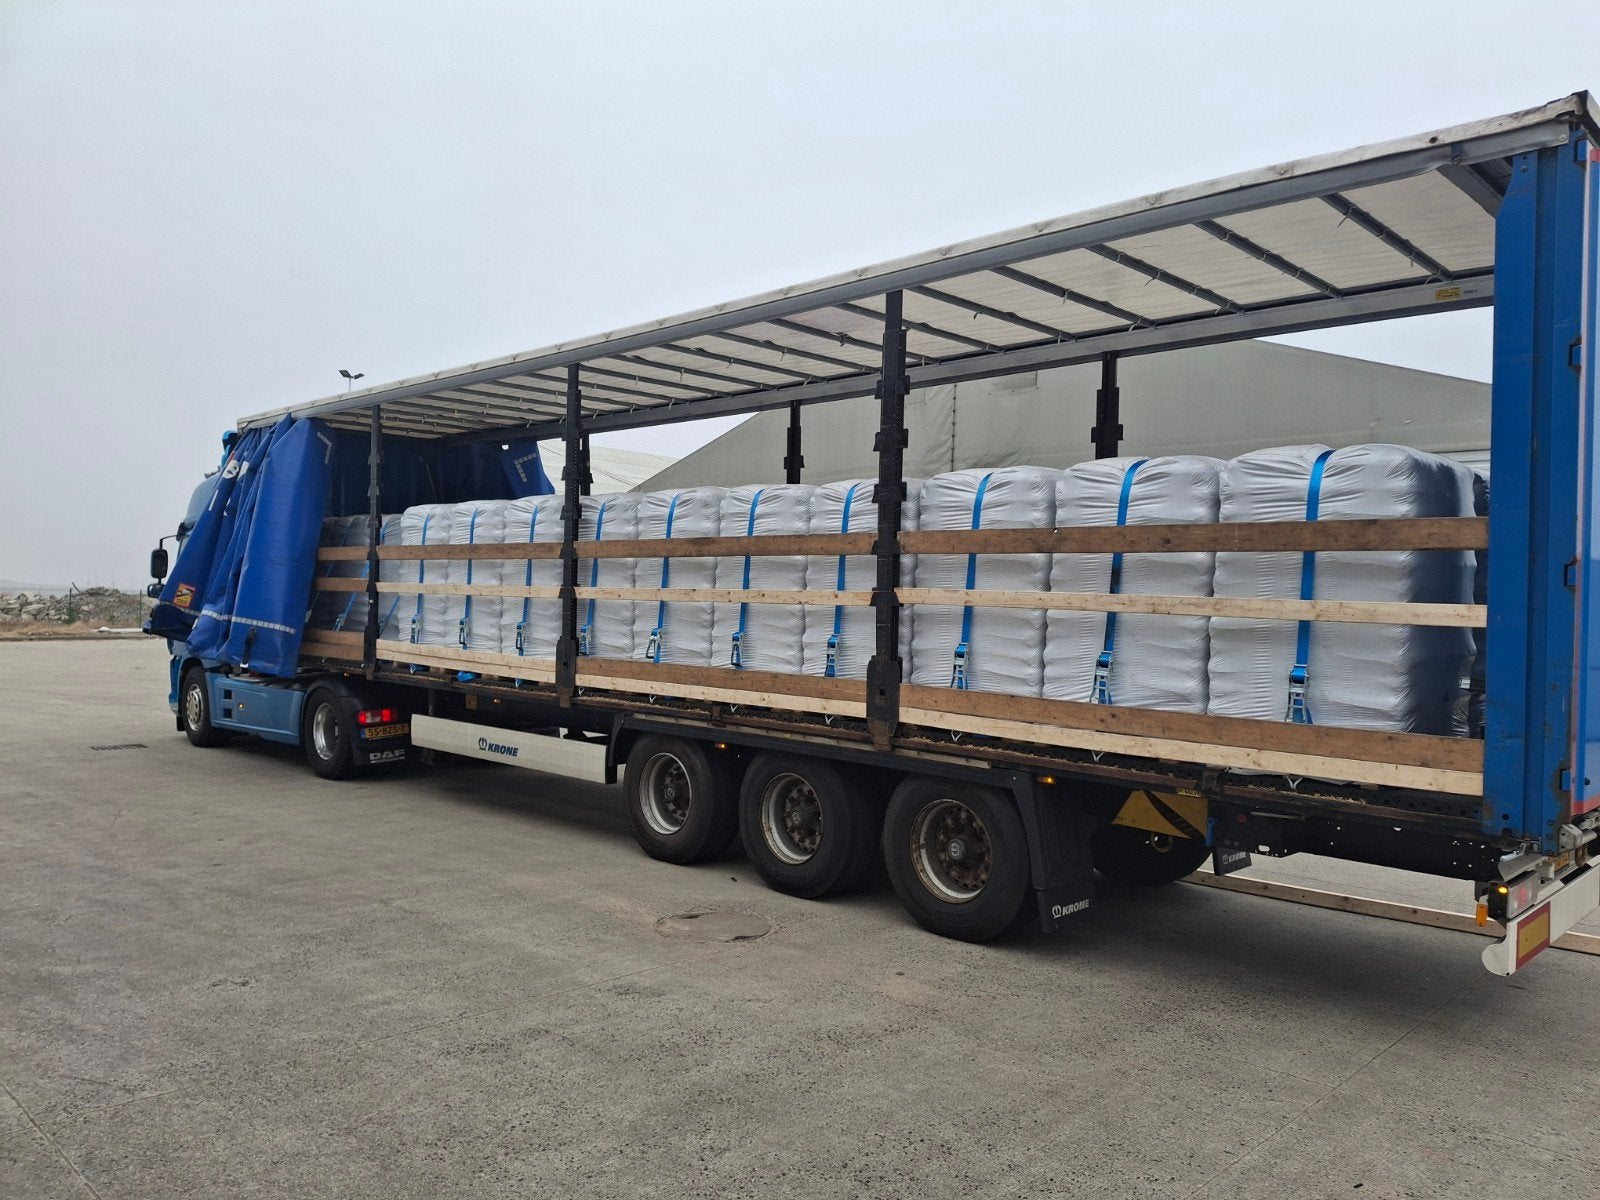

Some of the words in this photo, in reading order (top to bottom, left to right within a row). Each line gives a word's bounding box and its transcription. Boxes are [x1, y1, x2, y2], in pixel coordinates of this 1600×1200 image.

[369, 749, 405, 760] DAF
[488, 743, 519, 757] KRONE
[1062, 899, 1090, 916] KRONE
